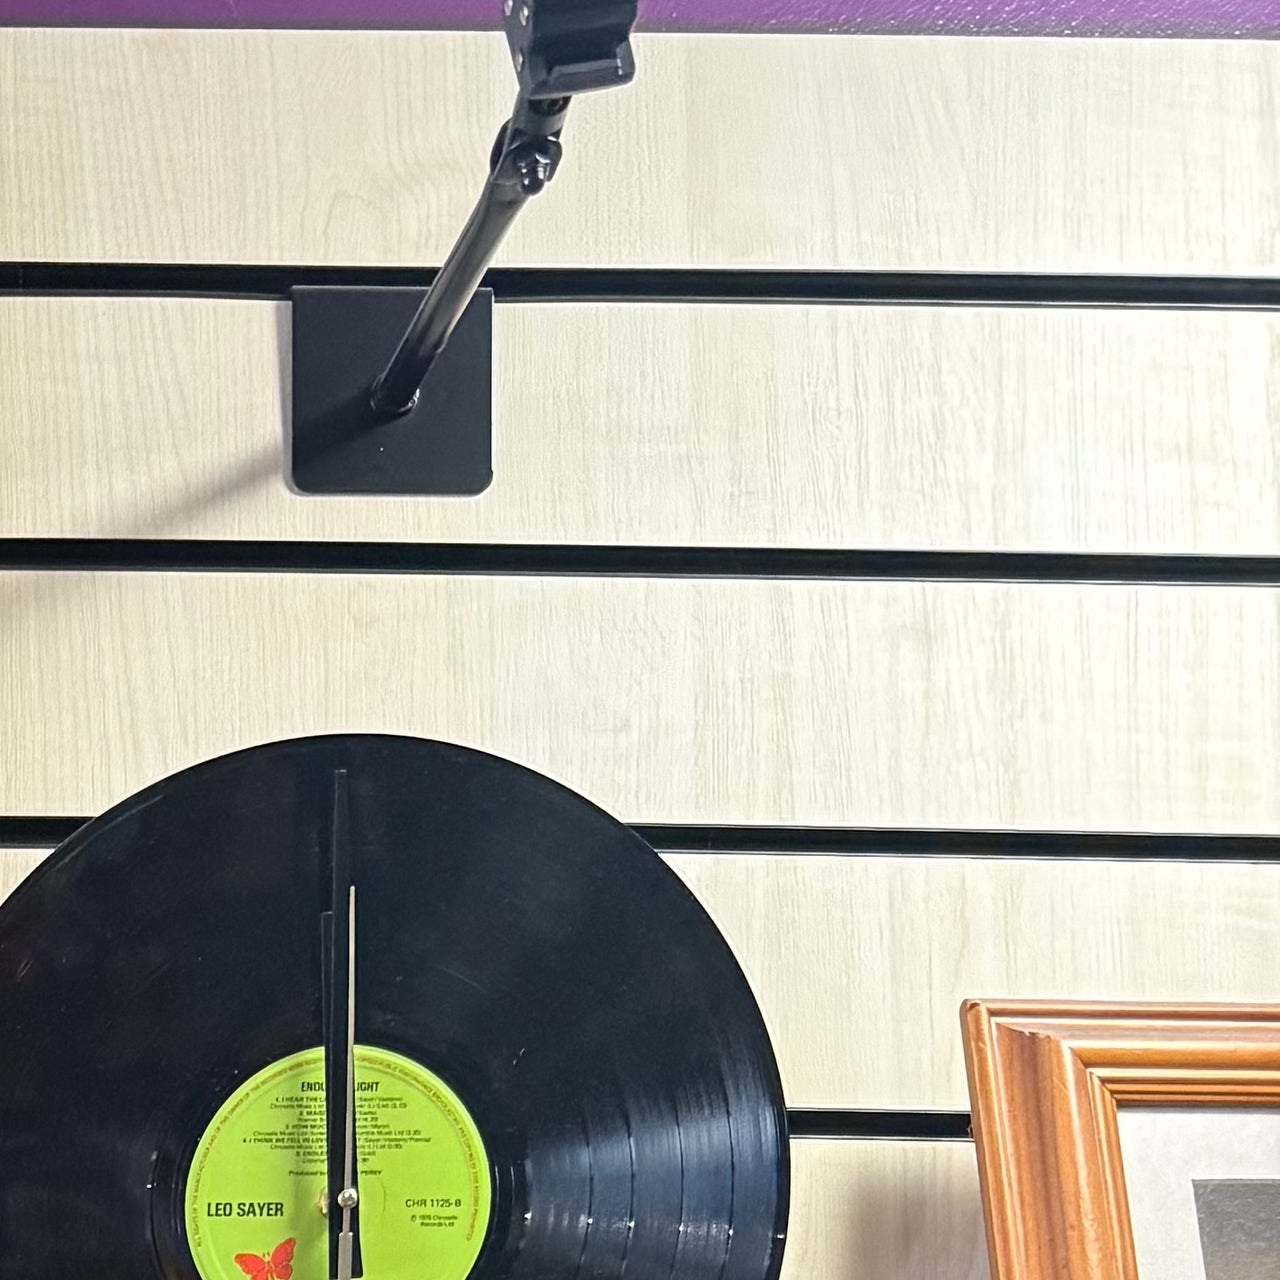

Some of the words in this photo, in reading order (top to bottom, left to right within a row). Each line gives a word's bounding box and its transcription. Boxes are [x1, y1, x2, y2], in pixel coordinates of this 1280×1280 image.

[405, 1198, 427, 1208] CHR
[207, 1202, 232, 1217] LEO
[237, 1202, 284, 1217] SAYER
